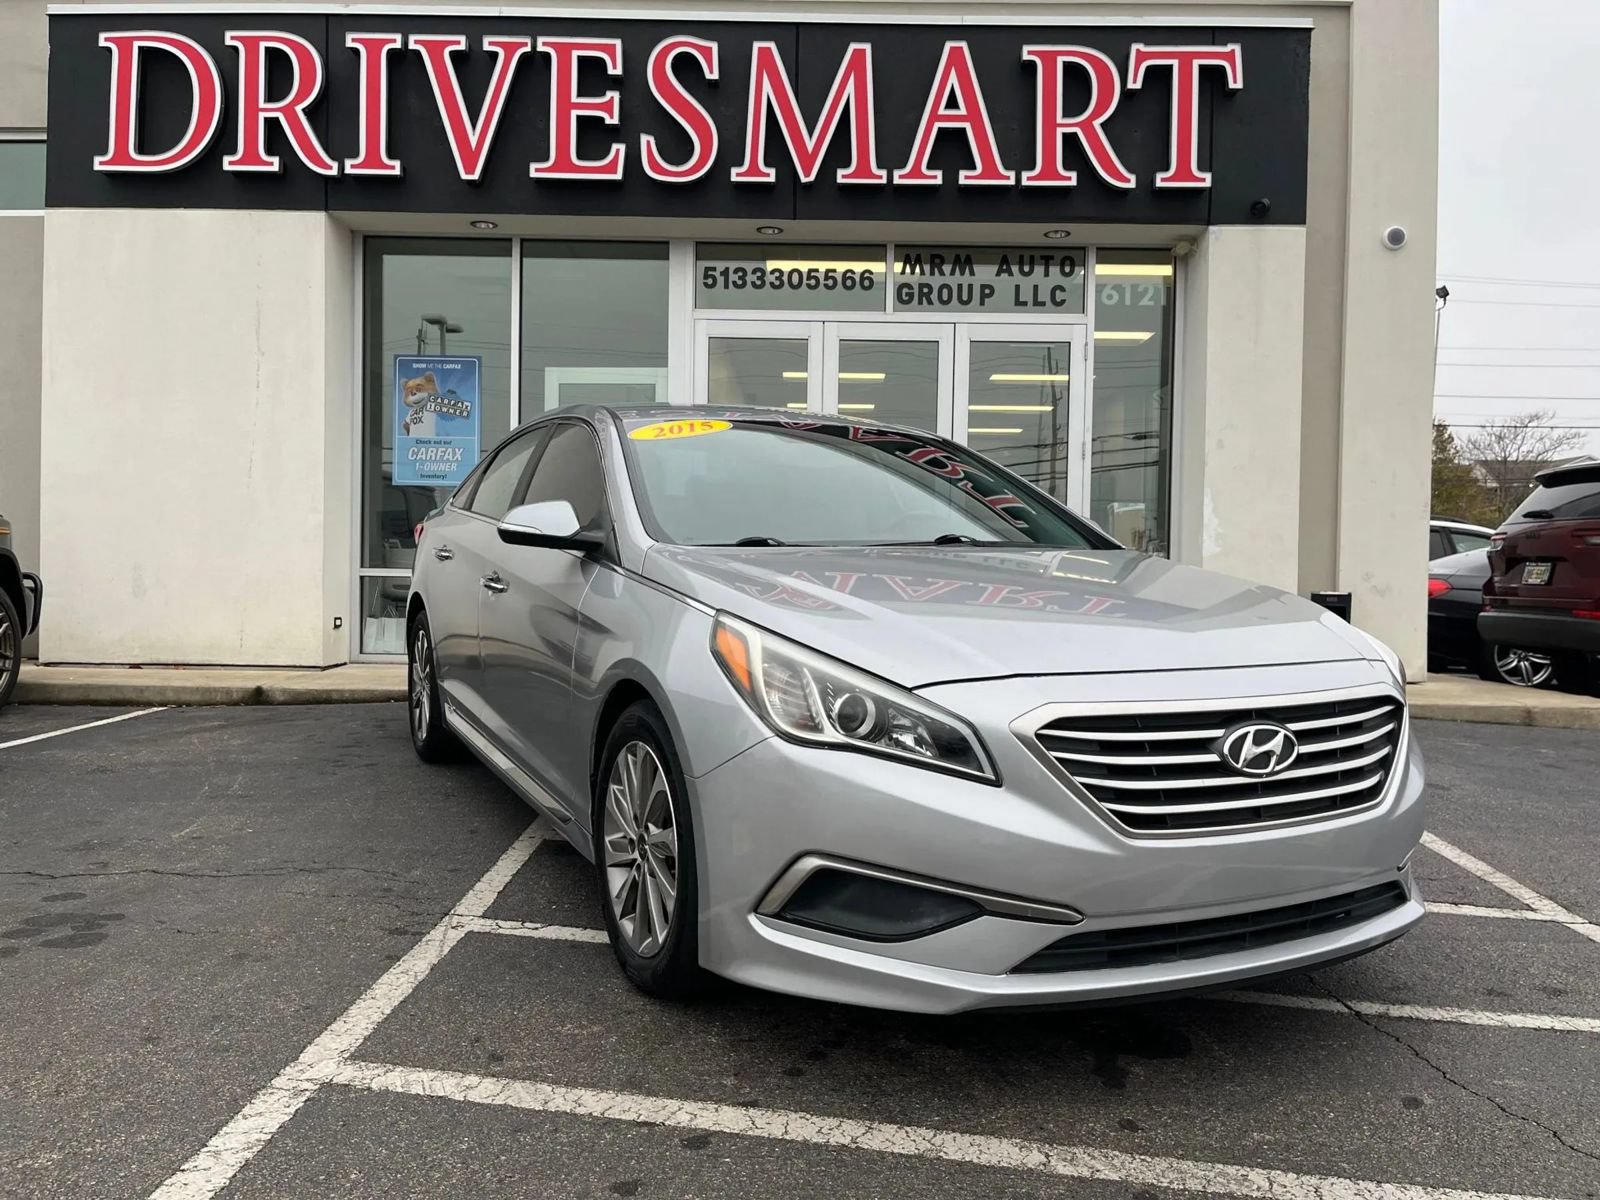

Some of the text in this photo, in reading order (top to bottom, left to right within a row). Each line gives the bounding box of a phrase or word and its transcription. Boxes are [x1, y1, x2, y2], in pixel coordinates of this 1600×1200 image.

[93, 29, 1244, 190] DRIVESMART
[900, 253, 1077, 278] MRM AUTO
[702, 266, 875, 291] 5133305566
[896, 282, 1067, 307] GROUP LLC
[1101, 284, 1167, 306] 6121
[653, 421, 714, 438] 2015
[408, 447, 464, 461] CARFAX
[415, 462, 458, 471] 1-OWNER
